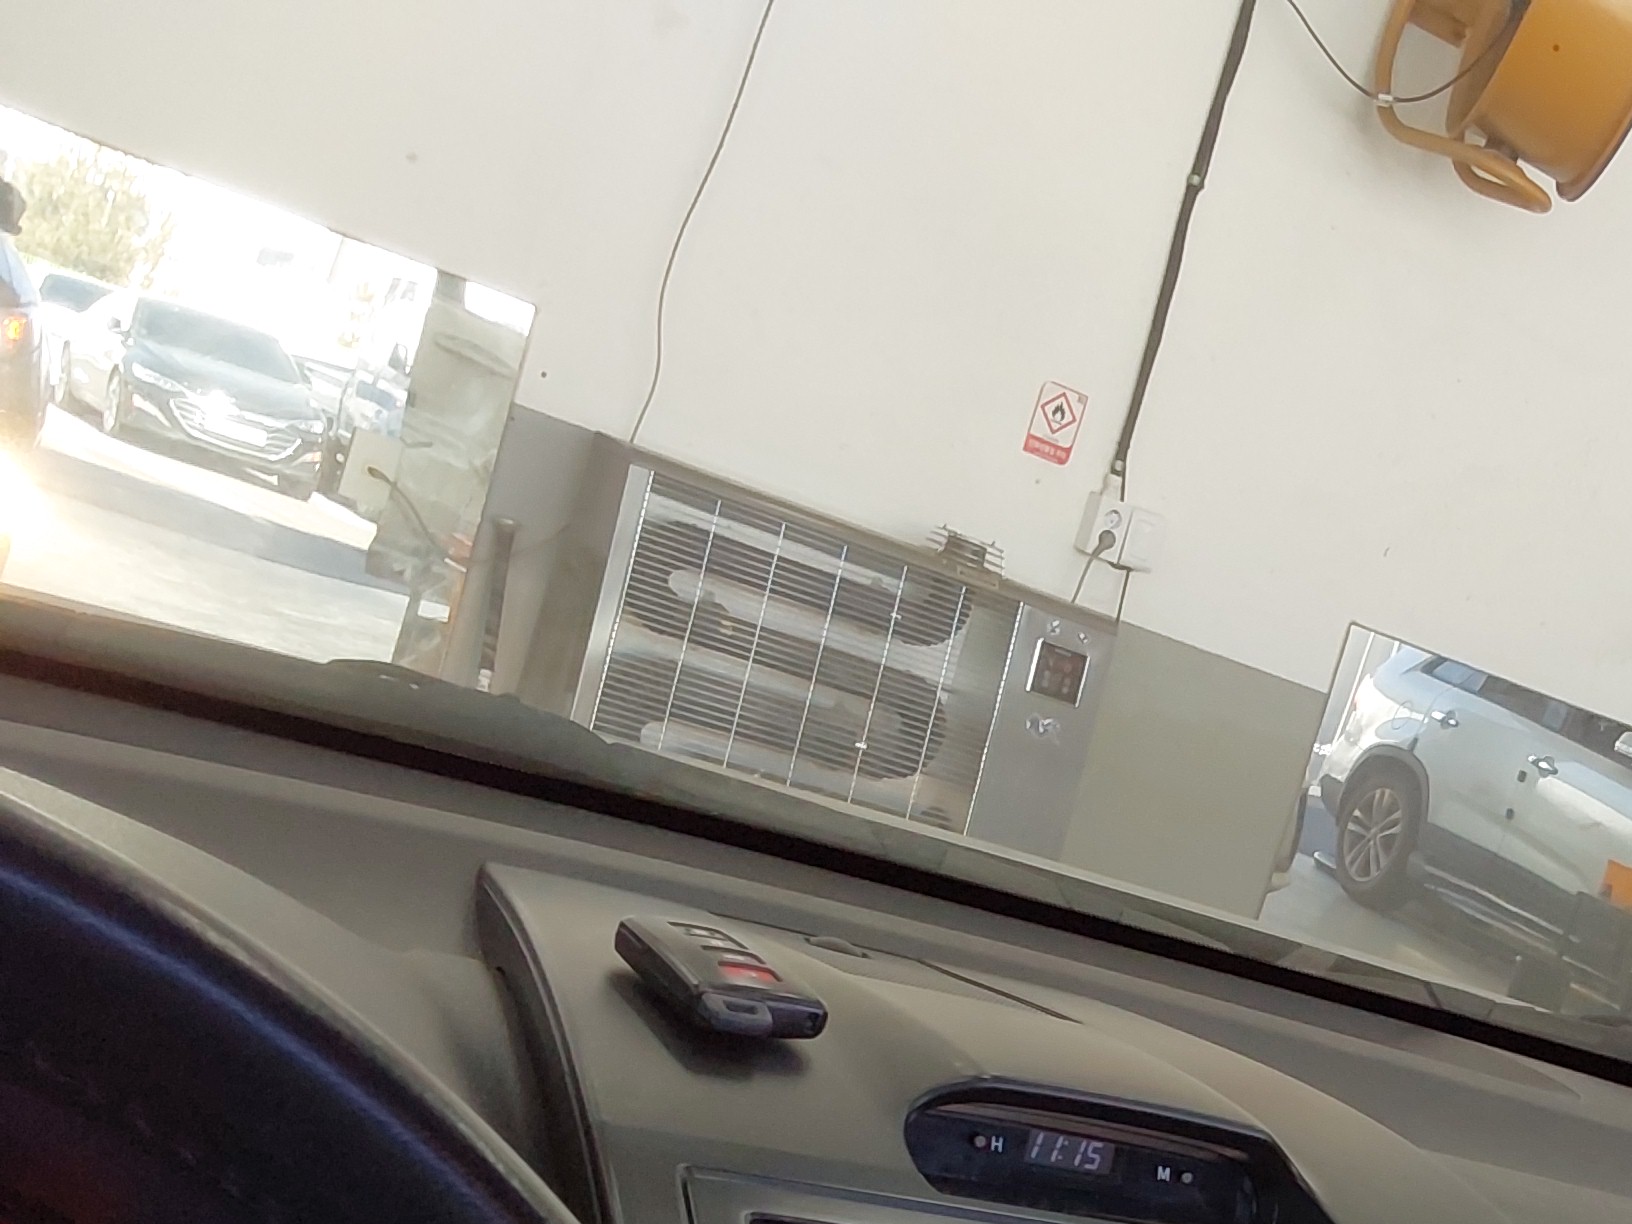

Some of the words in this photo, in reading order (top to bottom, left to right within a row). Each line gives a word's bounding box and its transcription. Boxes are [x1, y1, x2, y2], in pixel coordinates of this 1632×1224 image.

[990, 1135, 1004, 1153] H
[1030, 1131, 1105, 1171] 11:15
[1157, 1165, 1171, 1182] M
